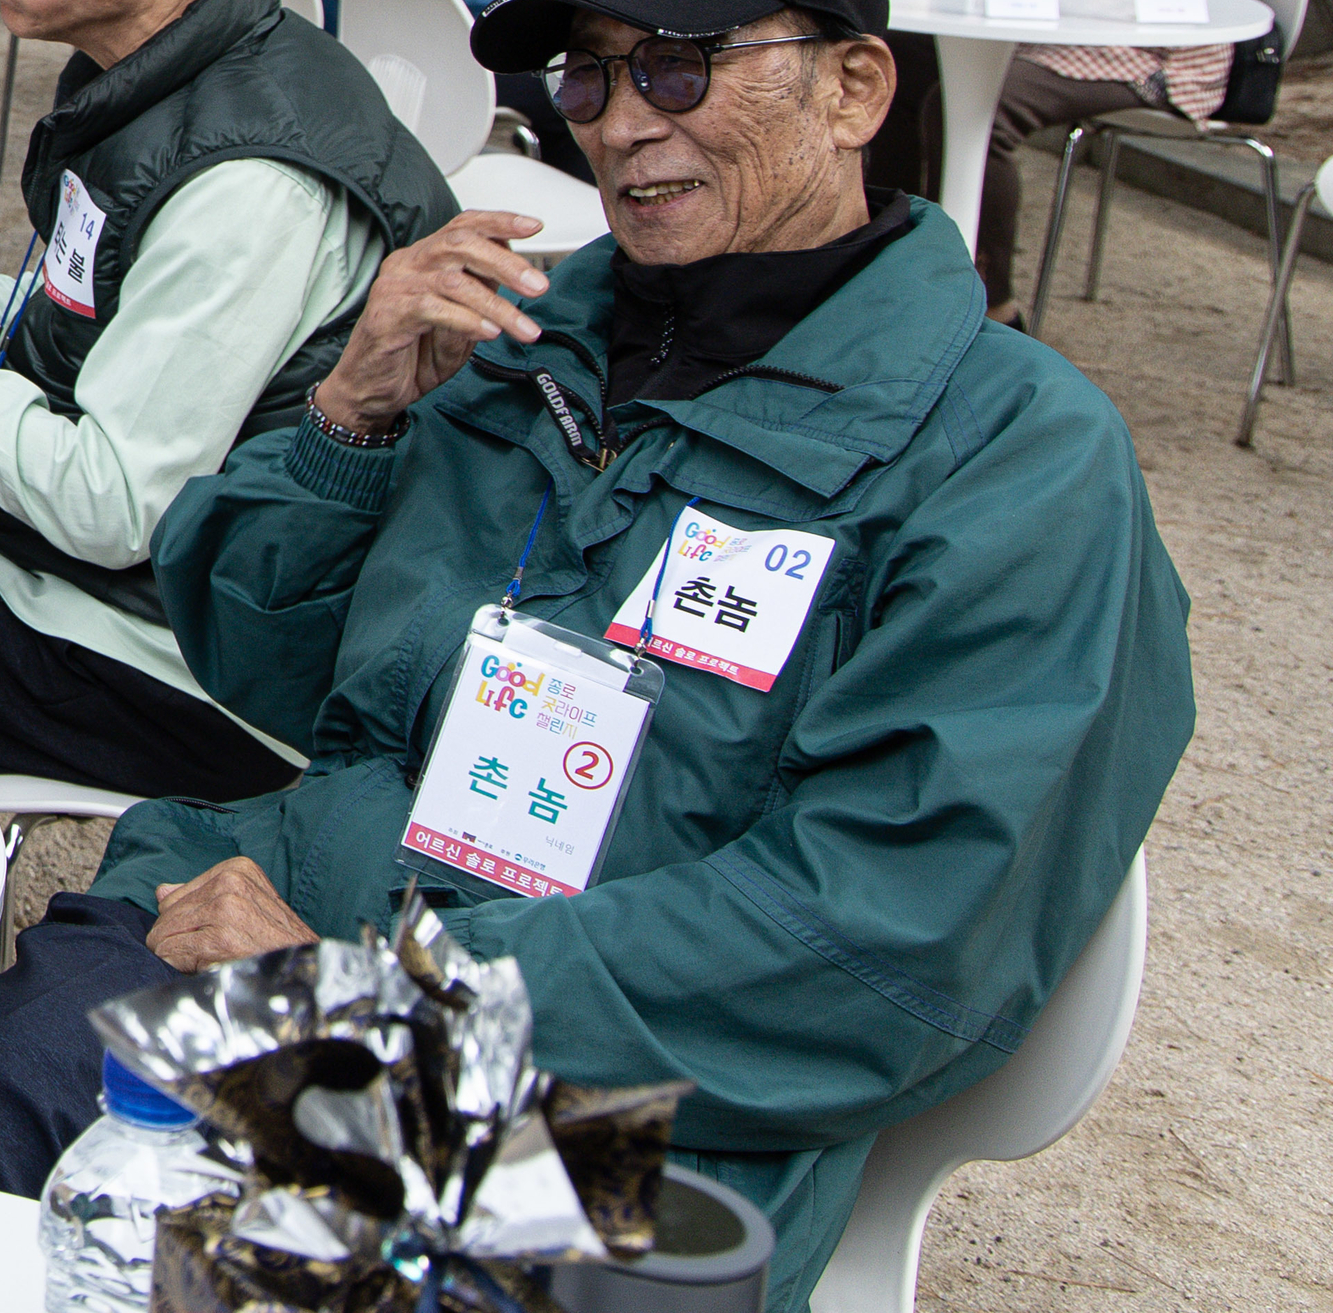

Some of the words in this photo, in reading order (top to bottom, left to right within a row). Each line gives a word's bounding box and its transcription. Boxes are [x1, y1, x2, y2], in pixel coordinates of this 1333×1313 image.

[80, 212, 95, 240] 14
[685, 522, 731, 549] Good
[764, 544, 812, 580] 02
[673, 577, 758, 633] 촌놈
[481, 654, 545, 697] Good
[675, 646, 697, 662] 솔로
[697, 655, 739, 676] 프로젝트
[548, 677, 576, 700] 종로
[536, 712, 578, 739] 챌린지
[541, 696, 598, 728] 굿라이프
[415, 830, 462, 861] 어르신
[466, 852, 496, 875] 솔로
[545, 835, 575, 855] 닉네임
